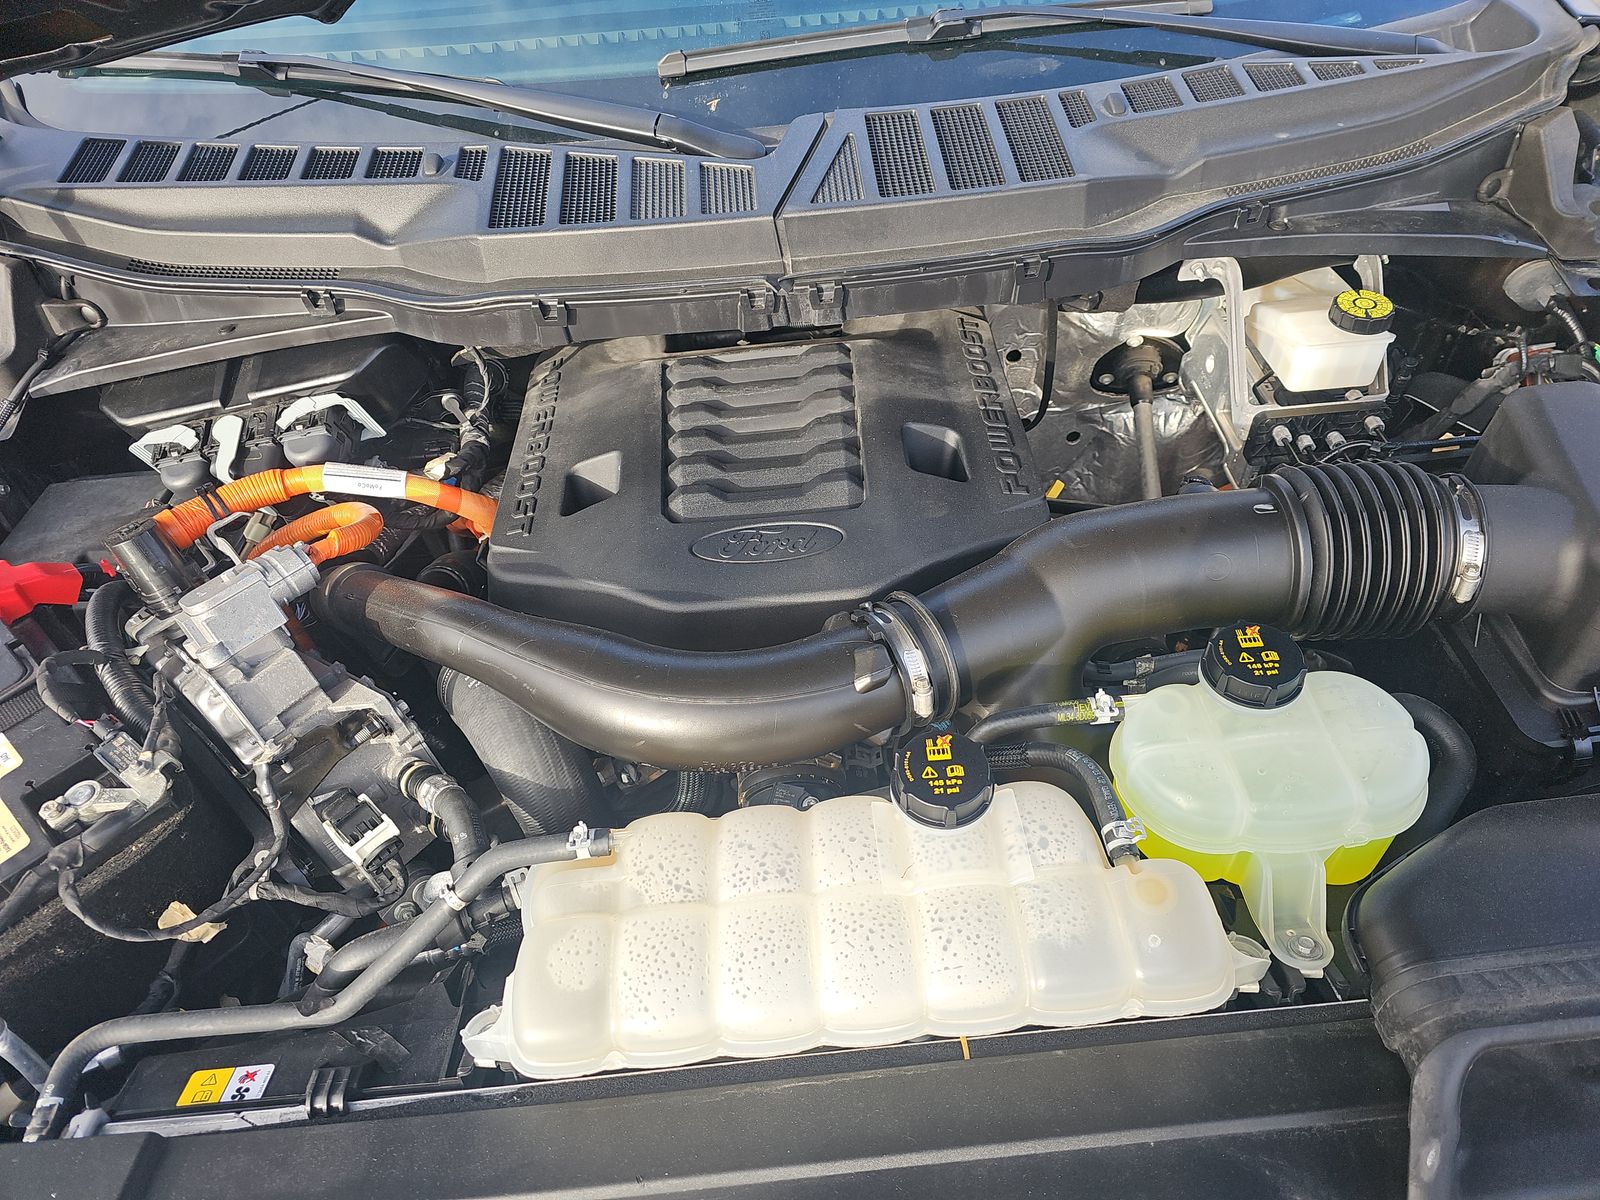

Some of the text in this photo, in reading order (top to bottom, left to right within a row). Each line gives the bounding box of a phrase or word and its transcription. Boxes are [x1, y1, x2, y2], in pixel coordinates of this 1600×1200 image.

[956, 316, 1030, 496] POWERBOOST
[505, 357, 564, 537] POWERBOOST
[718, 527, 817, 559] Ford
[1074, 703, 1091, 713] HEV
[928, 778, 963, 787] 145 kPa
[933, 786, 960, 795] 21 psi
